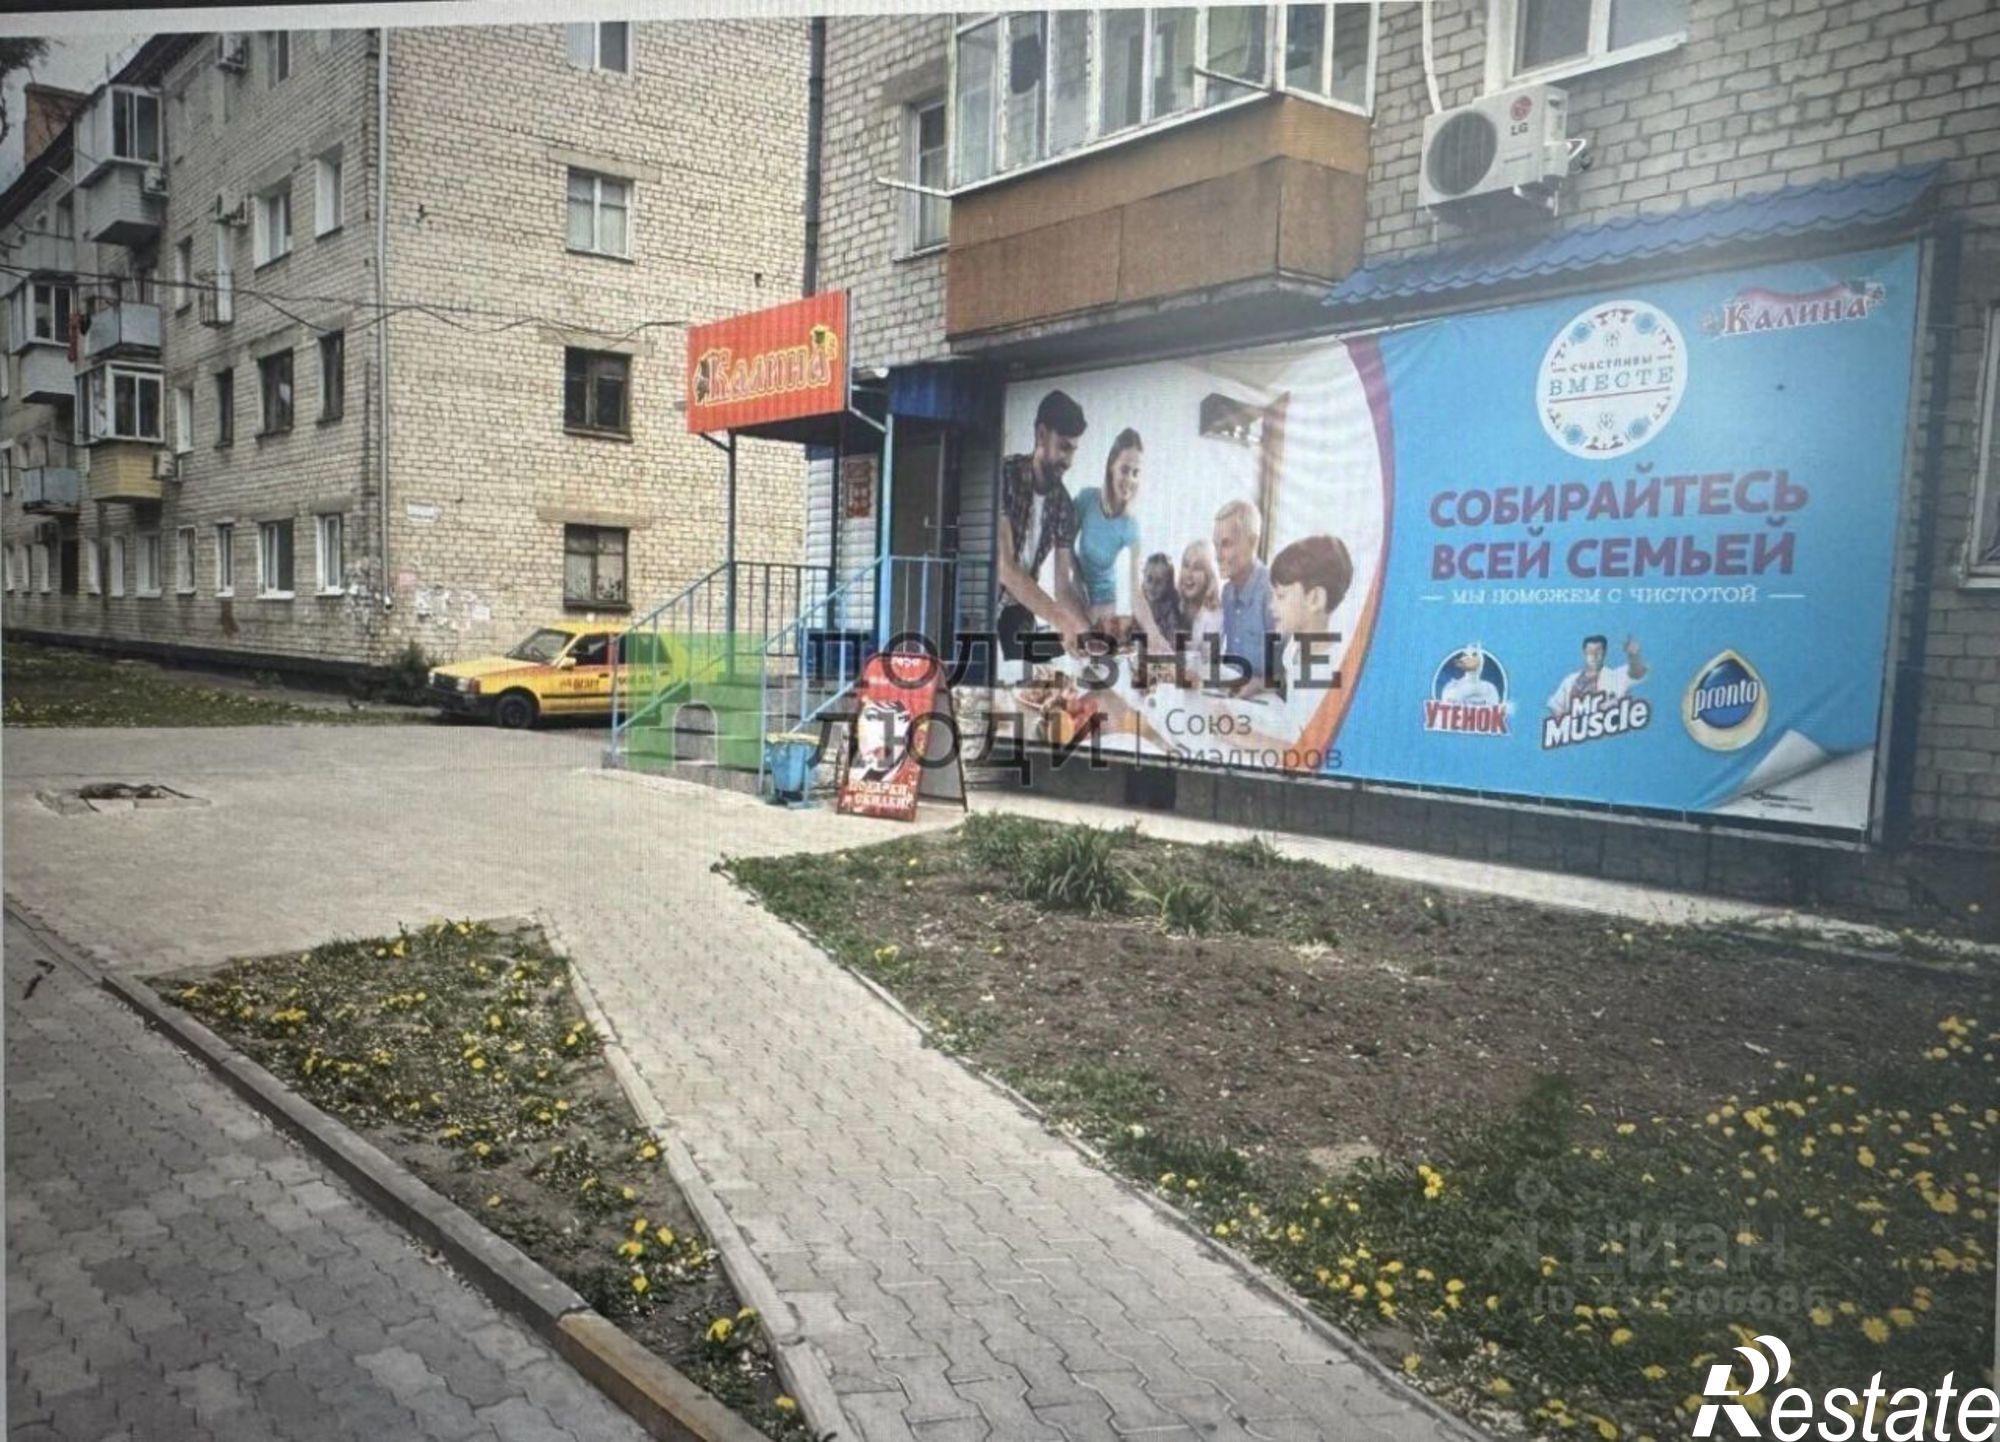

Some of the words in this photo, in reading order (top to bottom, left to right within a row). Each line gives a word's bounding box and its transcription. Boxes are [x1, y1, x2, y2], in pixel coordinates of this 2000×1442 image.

[1511, 121, 1529, 136] LG
[1725, 297, 1868, 335] Калина
[705, 346, 831, 403] Калина
[1549, 365, 1674, 397] ВМЕСТЕ
[1429, 462, 1809, 528] СОБИРАЙТЕСЬ
[1431, 525, 1550, 581] ВСЕЙ
[1566, 515, 1796, 579] СЕМЬЕЙ
[1452, 588, 1486, 604] МЫ
[1492, 587, 1602, 604] ПОМОЖЕМ
[1607, 587, 1622, 604] С
[1630, 583, 1759, 604] ЧИСТОТОЙ
[1425, 701, 1507, 734] УТЕНОК
[1572, 694, 1604, 718] Mr
[1693, 680, 1760, 720] pronto
[1544, 699, 1649, 747] Muscle
